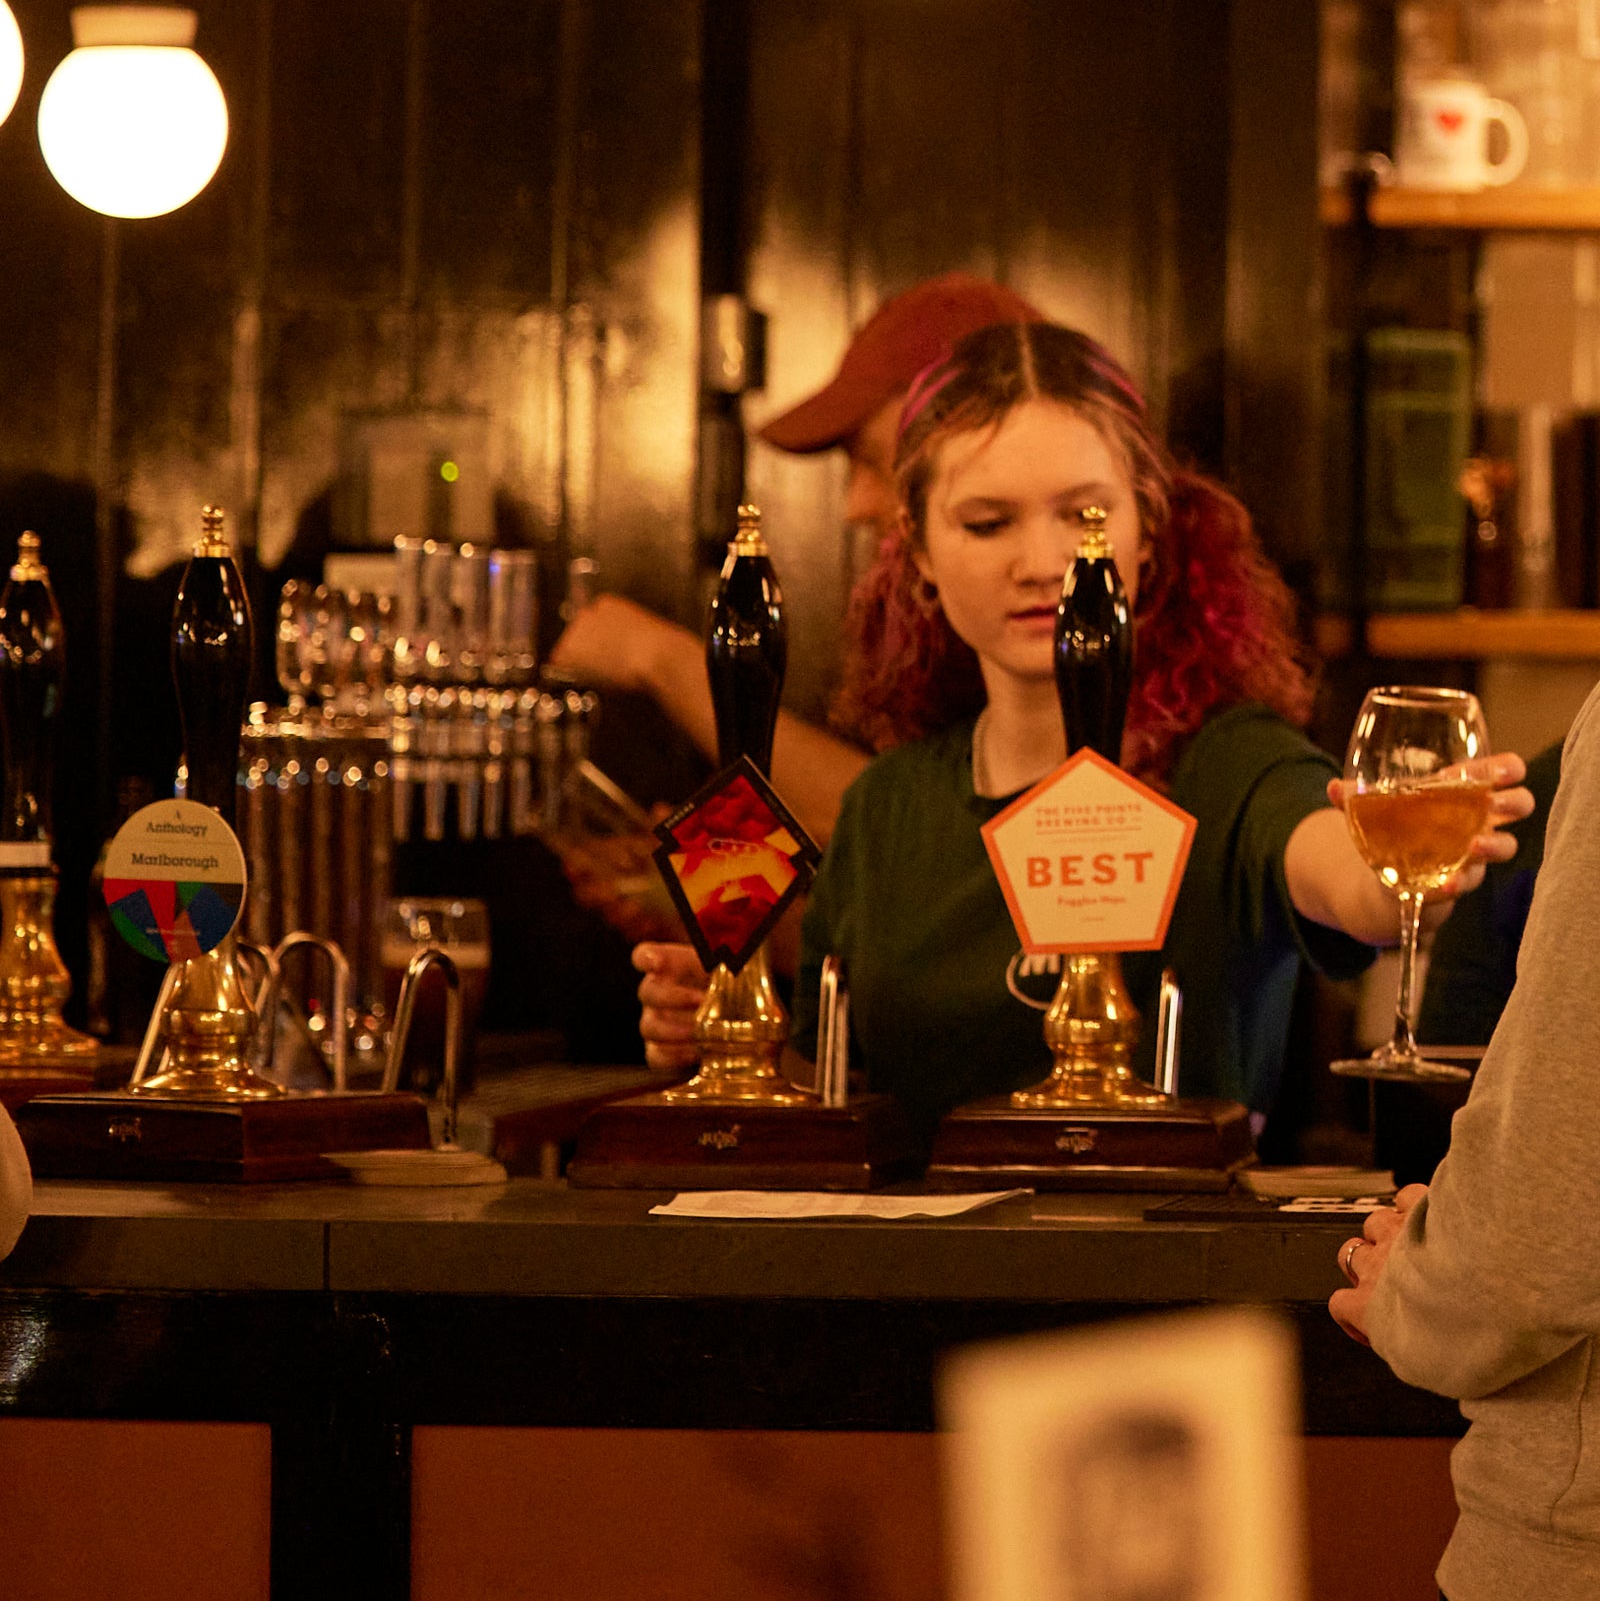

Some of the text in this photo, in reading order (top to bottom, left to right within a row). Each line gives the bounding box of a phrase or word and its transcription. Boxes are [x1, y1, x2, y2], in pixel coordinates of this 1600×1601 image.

[146, 821, 208, 837] Anthology
[132, 853, 218, 870] Marlborough
[1027, 851, 1154, 888] BEST
